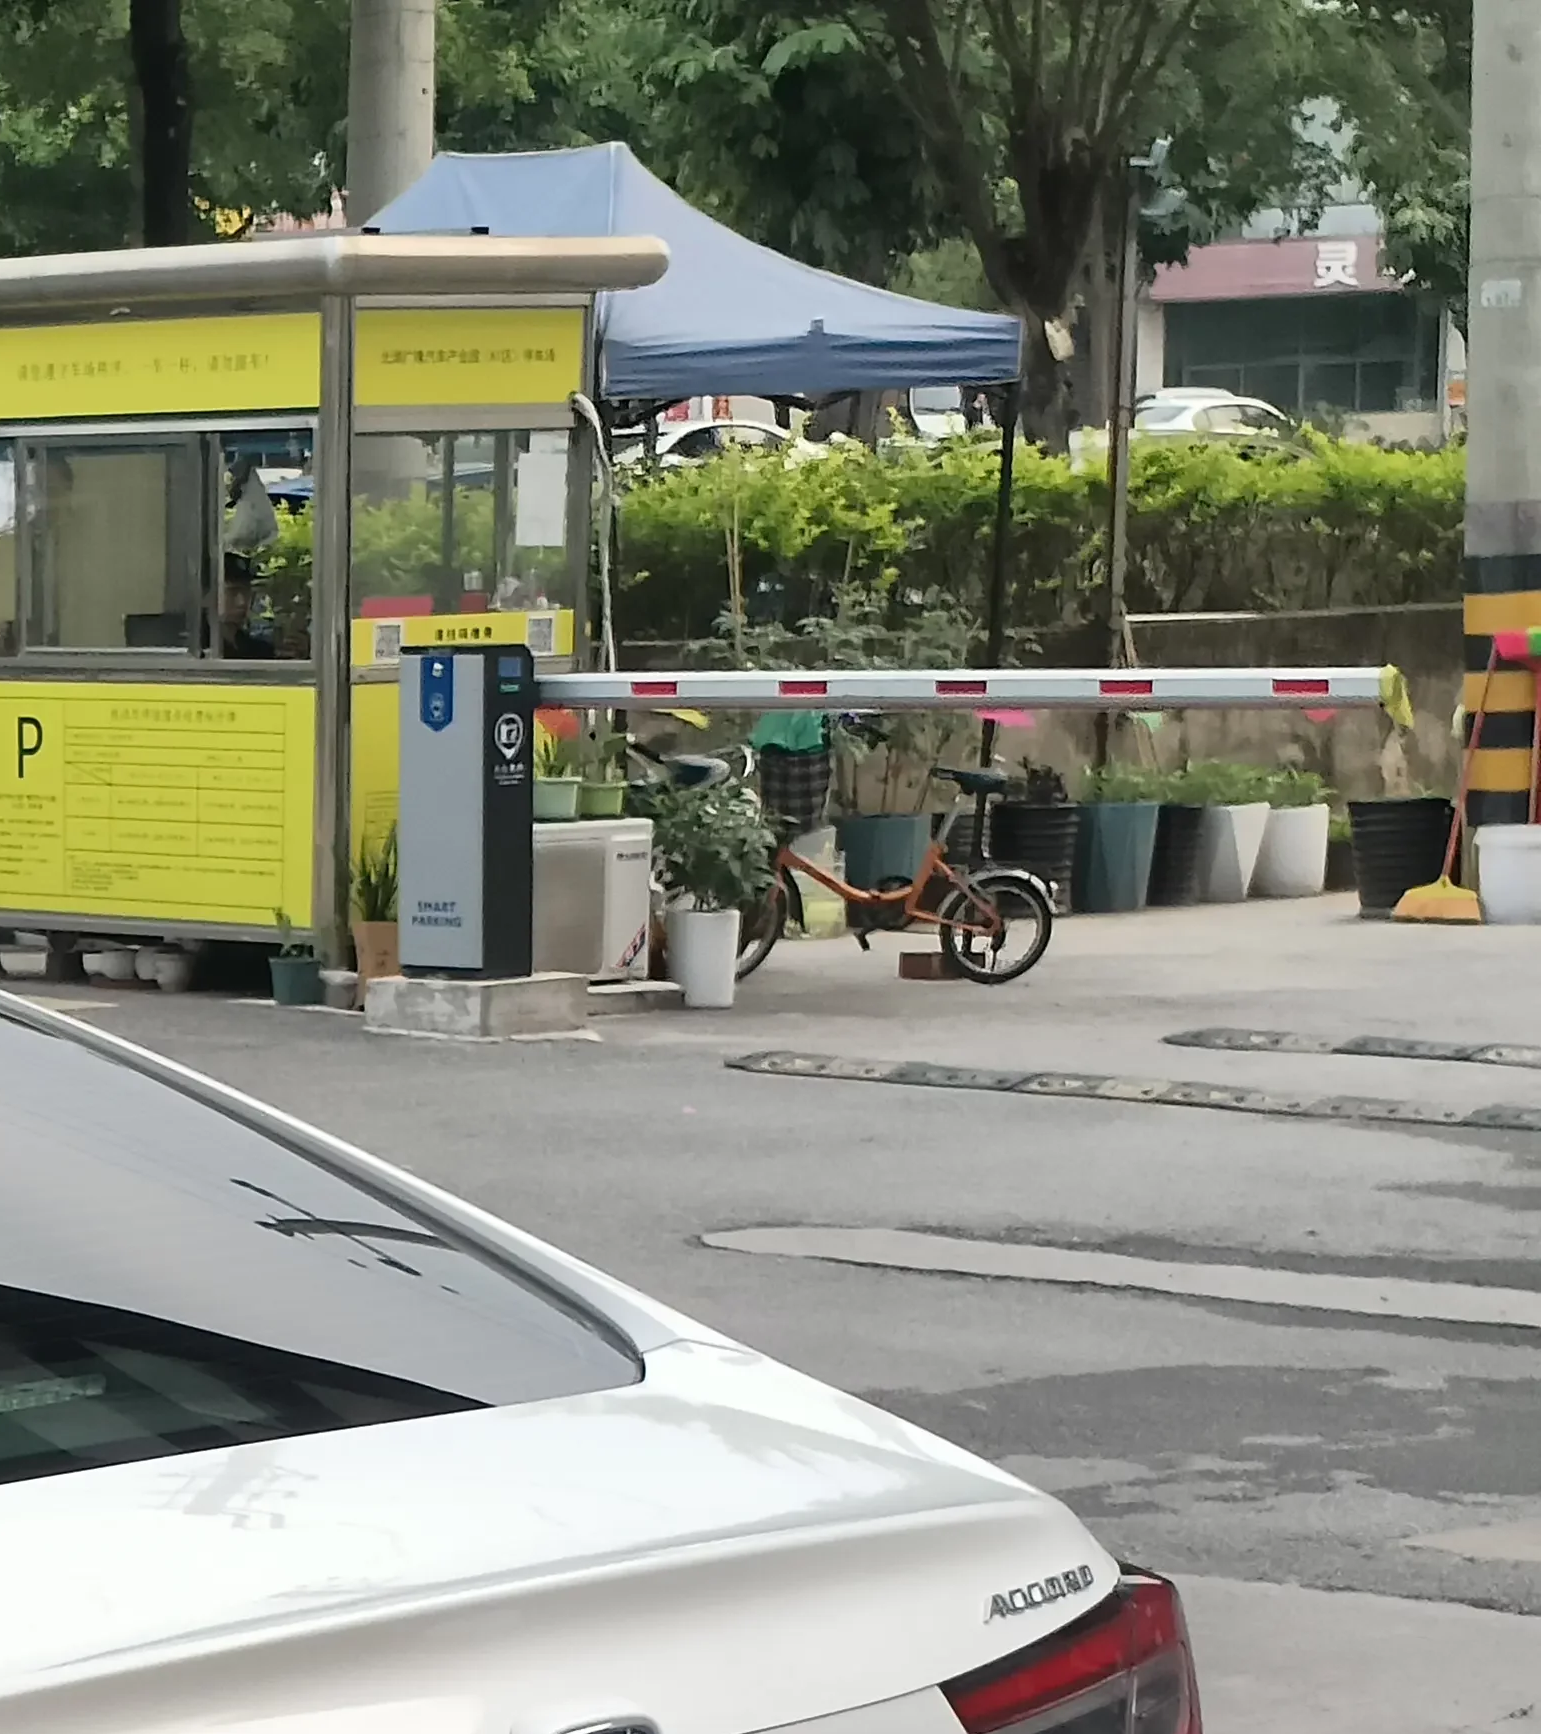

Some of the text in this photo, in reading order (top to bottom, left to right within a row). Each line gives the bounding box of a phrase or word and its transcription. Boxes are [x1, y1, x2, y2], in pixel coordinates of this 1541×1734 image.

[1314, 240, 1361, 289] 灵
[17, 716, 43, 778] P
[411, 915, 462, 928] PARKING
[417, 901, 456, 913] SMART
[982, 1564, 1095, 1624] ACCORD
